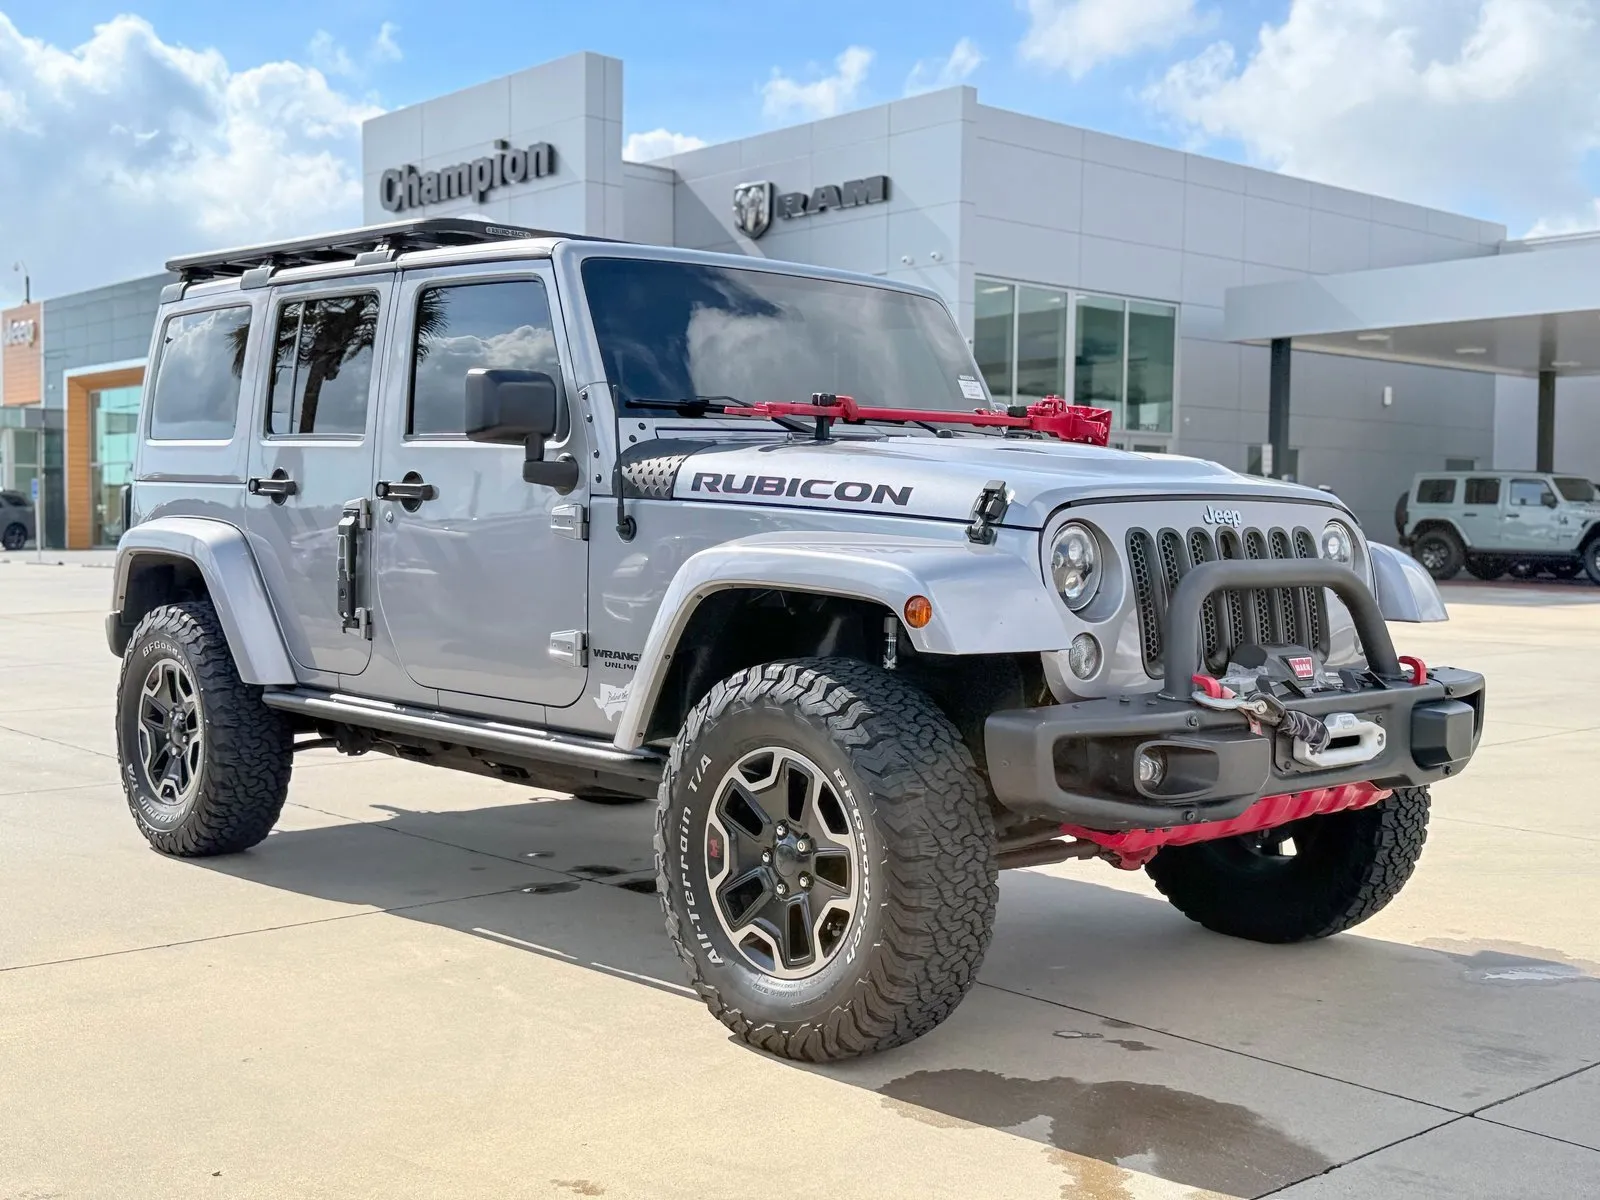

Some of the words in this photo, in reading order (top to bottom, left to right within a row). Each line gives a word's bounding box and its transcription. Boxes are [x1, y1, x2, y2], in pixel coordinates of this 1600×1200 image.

[380, 139, 557, 212] Champion
[776, 175, 887, 219] RAM
[691, 472, 914, 506] RUBICON
[1203, 505, 1241, 528] Jeep
[143, 640, 192, 680] BFGood
[687, 754, 712, 793] T/A
[679, 806, 724, 964] All-Terrain
[833, 768, 870, 966] BFGoodrich
